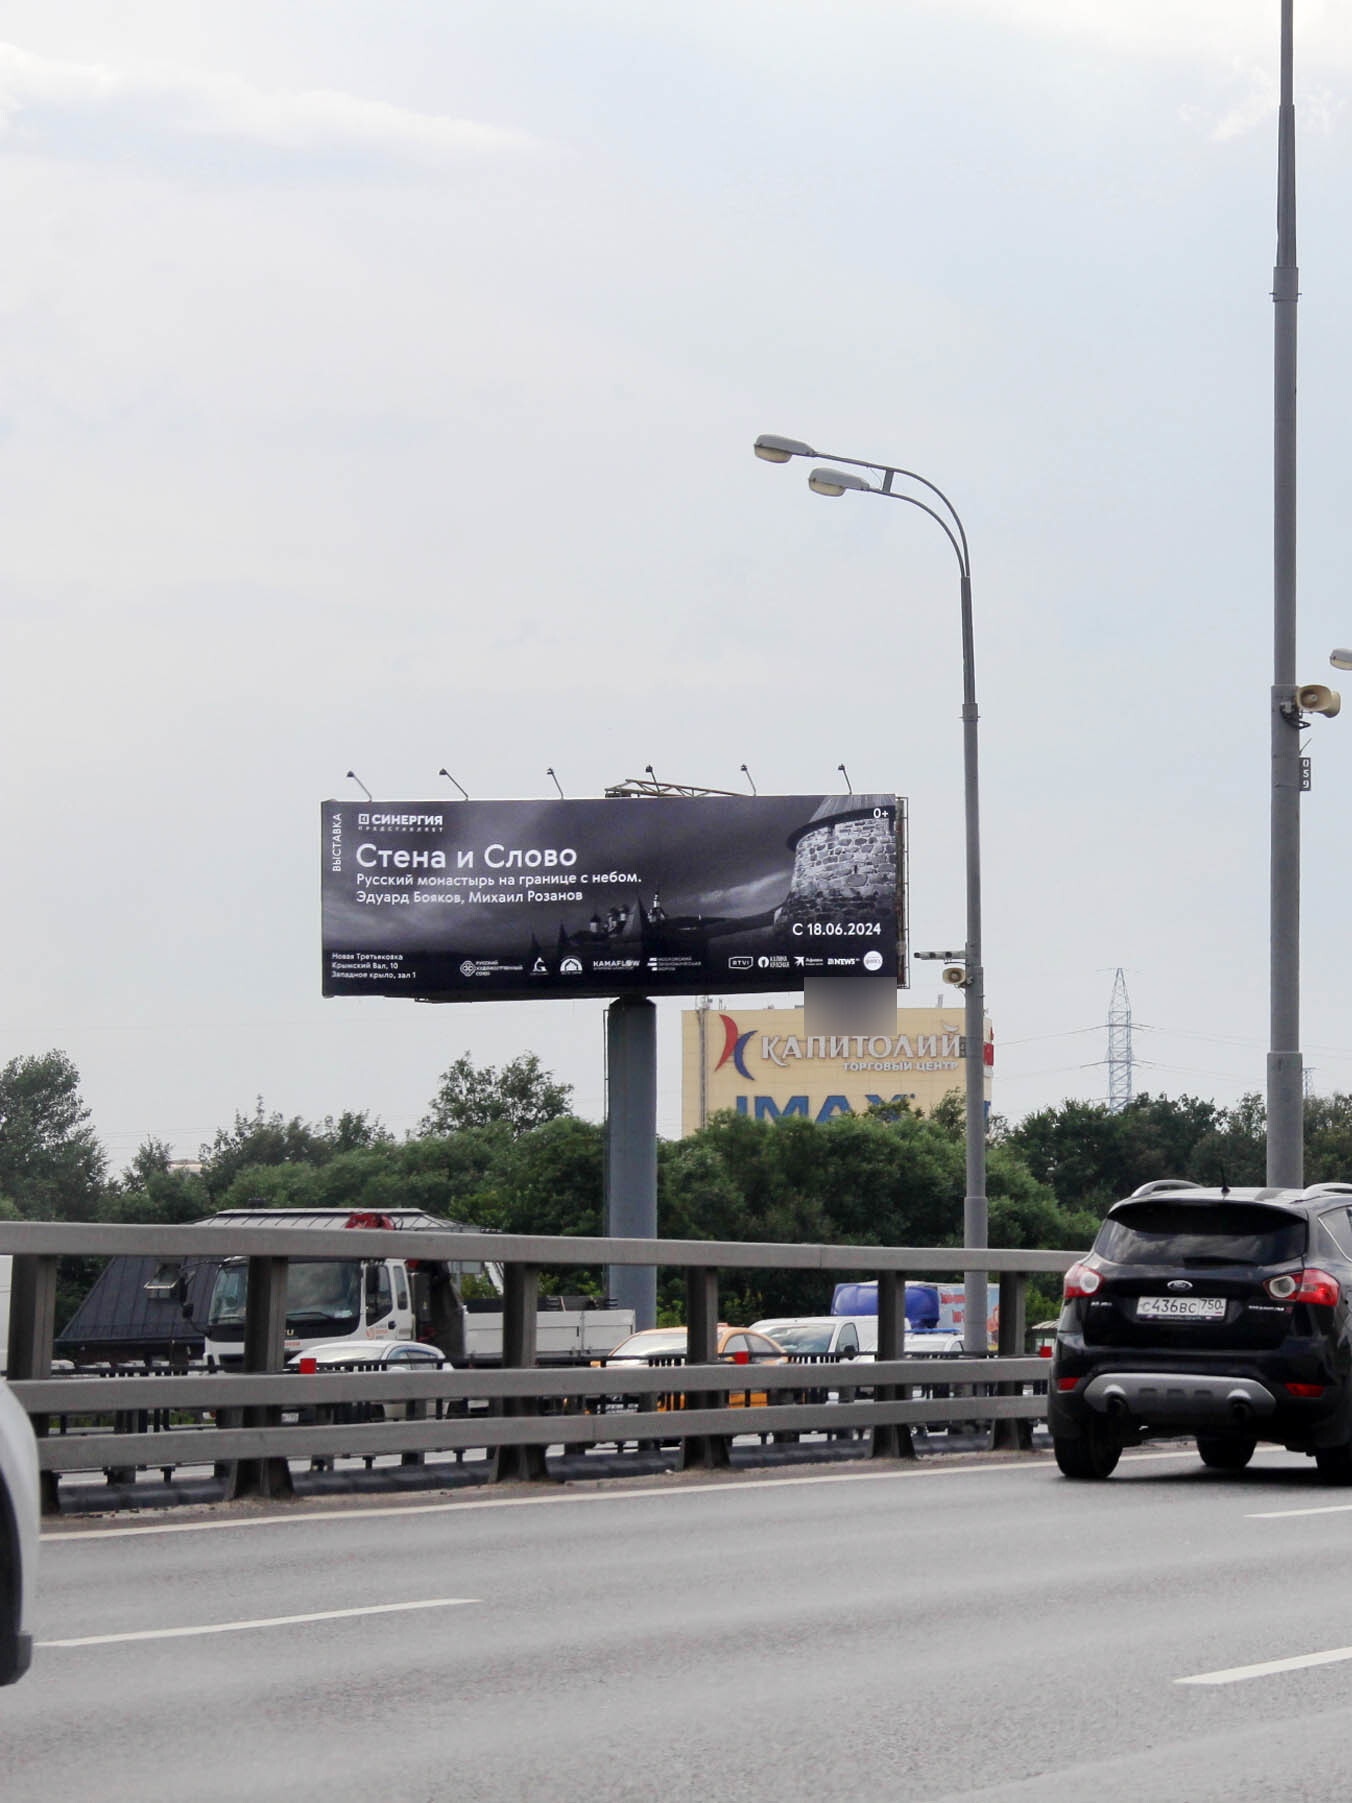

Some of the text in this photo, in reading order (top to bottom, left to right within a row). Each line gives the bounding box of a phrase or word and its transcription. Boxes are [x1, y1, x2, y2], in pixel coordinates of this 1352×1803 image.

[371, 814, 443, 826] СИНЕРГИЯ
[873, 807, 889, 819] 0+
[332, 813, 342, 872] ВЫСТАВКА
[356, 843, 577, 868] Стена и Слово
[356, 871, 642, 888] Русский монастырь на границе с небом.
[356, 890, 583, 905] Эдуард Бояков, Михаил Розанов
[807, 922, 882, 936] 18.06.2024
[356, 953, 403, 961] Третьяковка
[372, 962, 389, 970] Вал,
[760, 1023, 961, 1067] КАПИТОЛИЙ
[843, 1060, 959, 1072] ТОРГОВЫЙ ЦЕНТР
[1141, 1300, 1221, 1315] С436ВС 750
